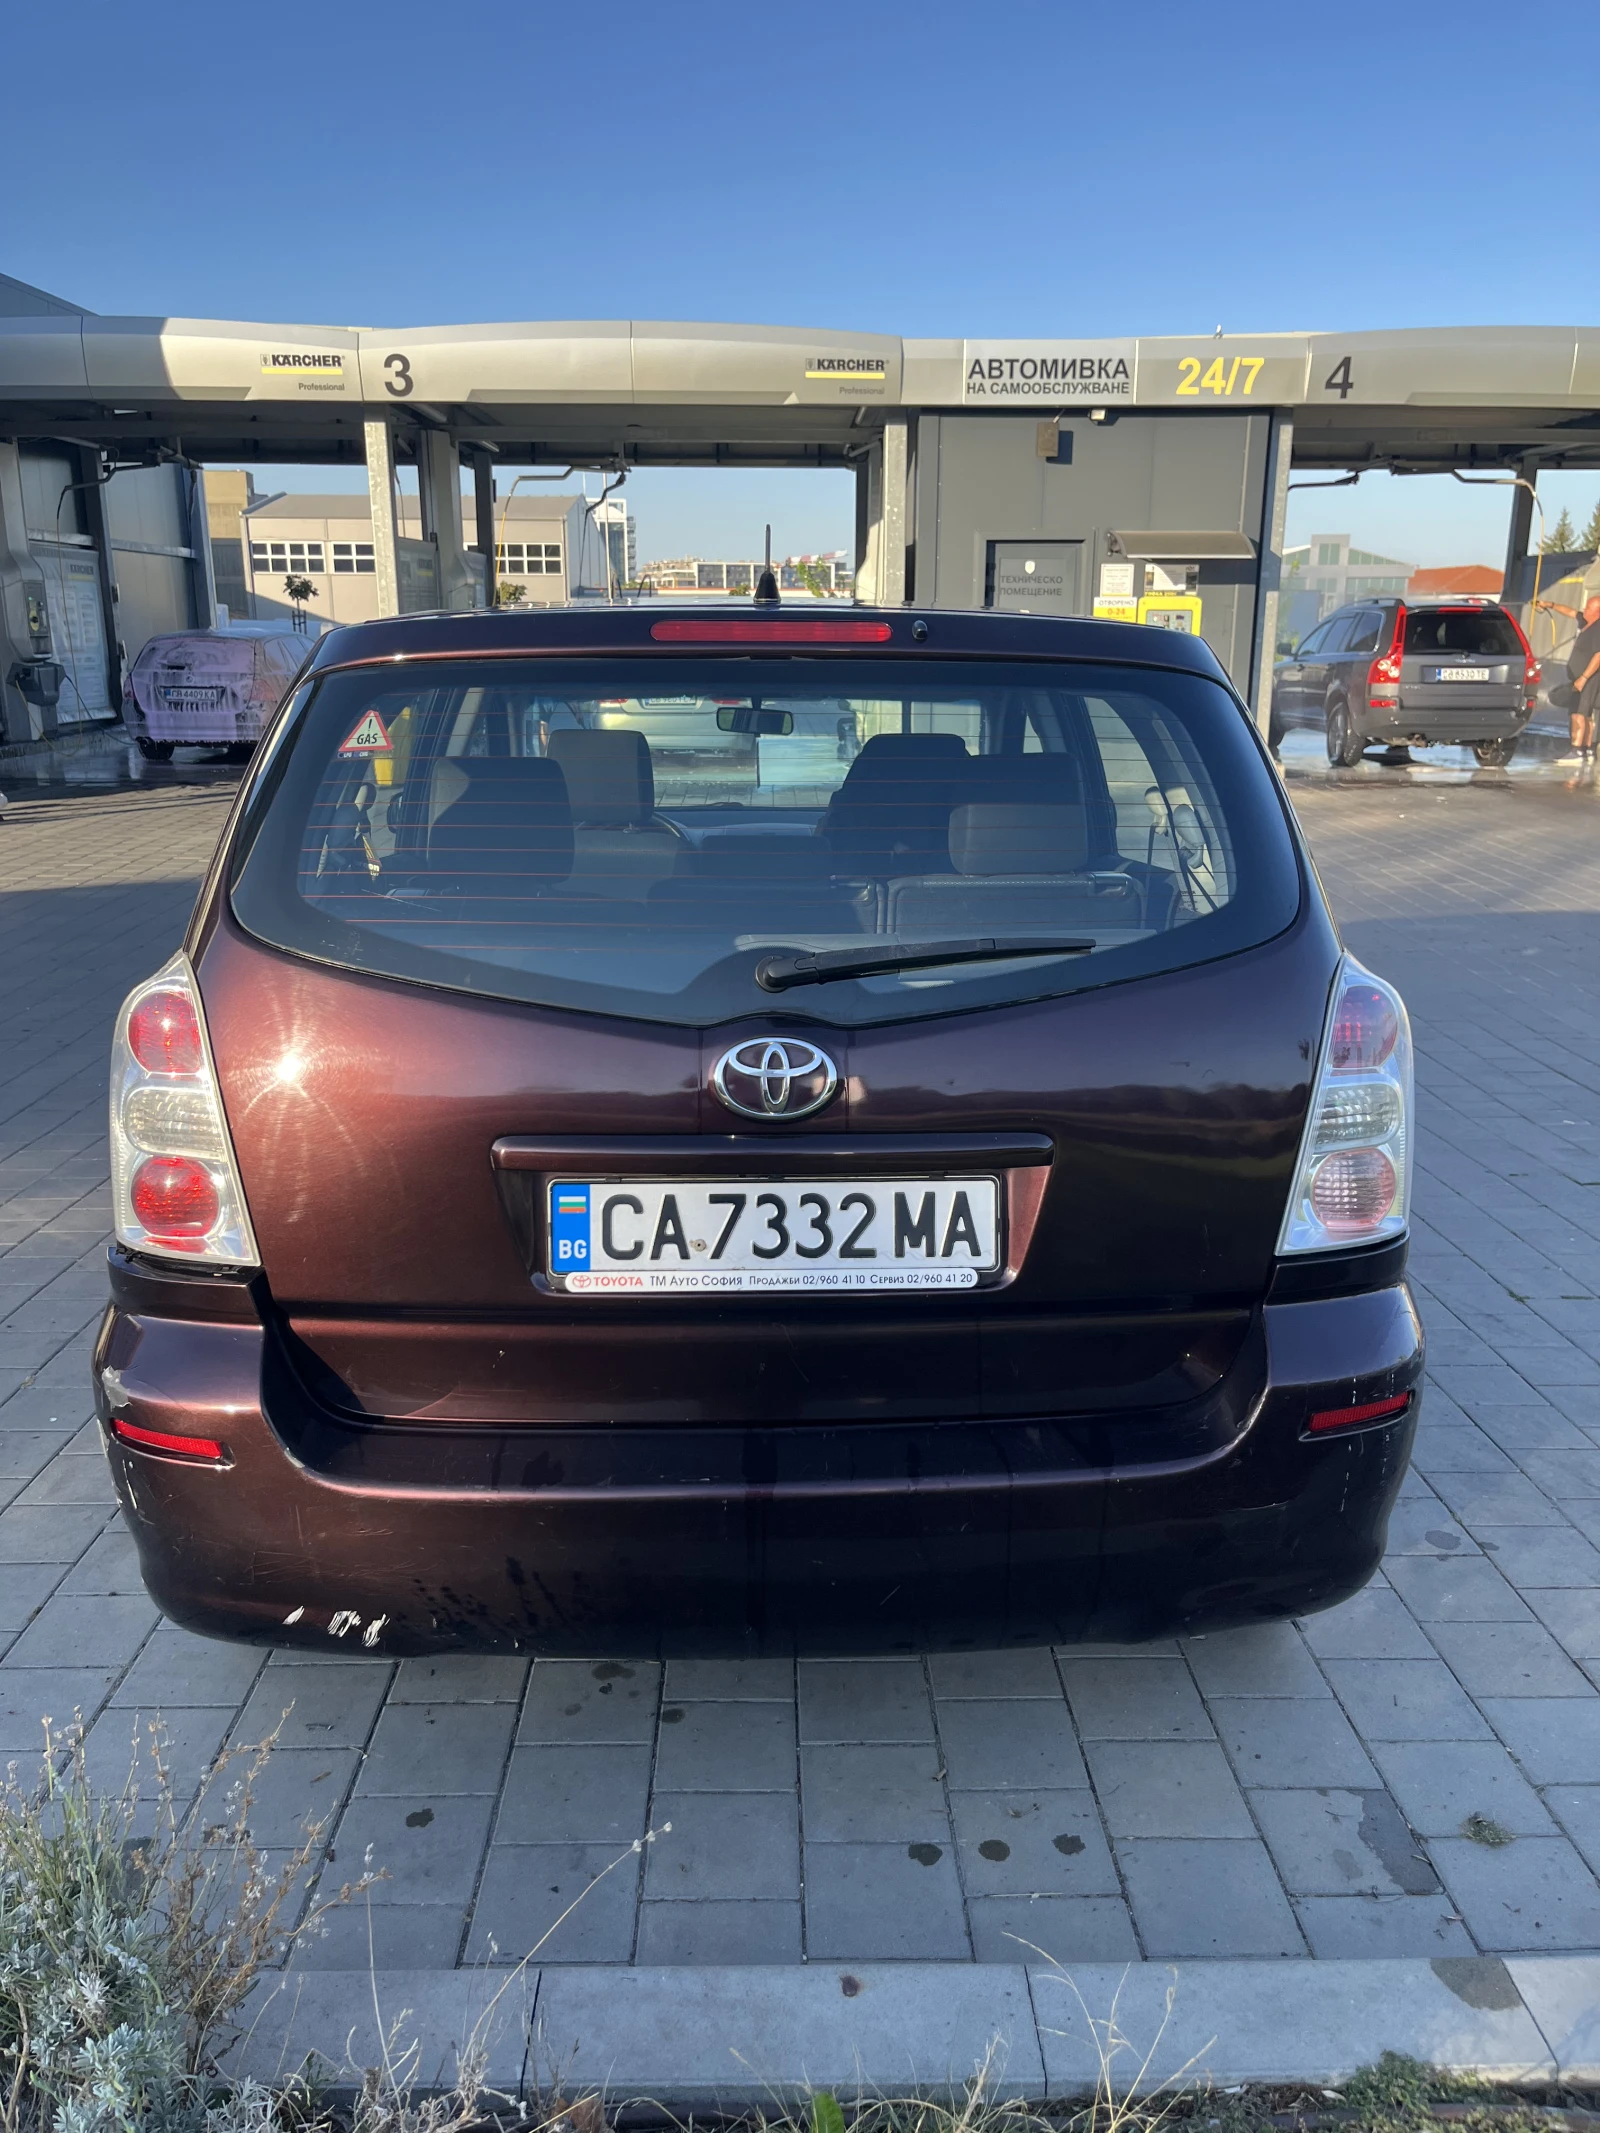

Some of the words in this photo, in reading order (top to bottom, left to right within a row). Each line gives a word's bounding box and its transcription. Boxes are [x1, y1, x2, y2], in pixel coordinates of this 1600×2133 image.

[271, 354, 342, 367] KÄRCHER
[817, 358, 885, 371] KÄRCHER
[384, 353, 414, 397] 3
[968, 358, 1130, 380] АВТОМИВКА
[1175, 356, 1265, 396] 24/7
[1324, 356, 1354, 399] 4
[298, 383, 345, 391] Professional
[839, 386, 885, 395] Professional
[967, 383, 986, 395] НА
[990, 382, 1130, 395] САМООБСЛУЖВАНЕ
[1000, 575, 1063, 584] ТЕХНИЧЕСКО
[999, 587, 1063, 596] ПОМЕЩЕНИЕ
[1107, 608, 1126, 616] 0-24
[356, 733, 378, 745] GAS
[601, 1193, 691, 1261] CA
[708, 1192, 877, 1260] 7332
[893, 1191, 982, 1258] MA
[558, 1239, 587, 1259] BG
[593, 1276, 643, 1287] TOYOTA
[802, 1275, 838, 1286] 02/960
[841, 1275, 852, 1285] 41
[856, 1275, 865, 1285] 10
[907, 1274, 943, 1285] 02/960
[945, 1274, 956, 1284] 41
[960, 1273, 973, 1283] 20
